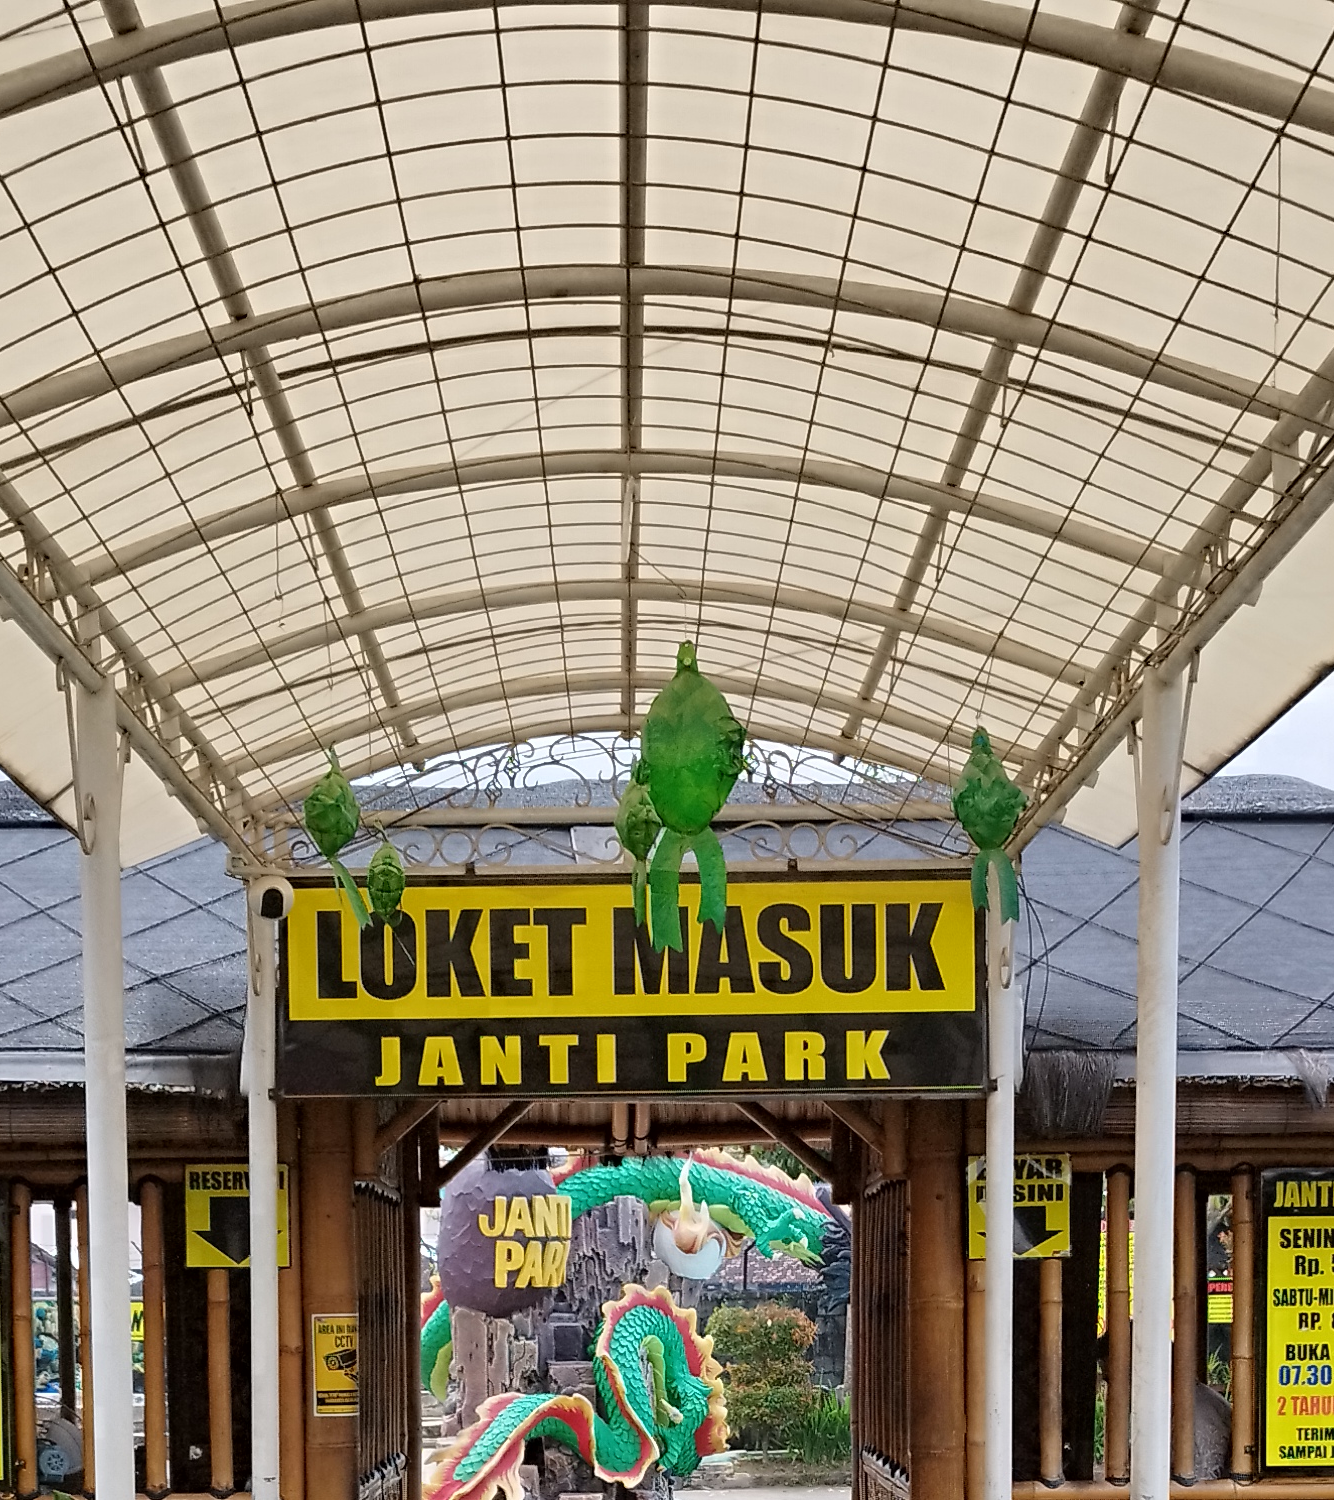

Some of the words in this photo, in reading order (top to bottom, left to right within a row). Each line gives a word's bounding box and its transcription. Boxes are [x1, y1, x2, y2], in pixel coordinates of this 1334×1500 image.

[317, 907, 586, 1000] LOKET
[613, 902, 946, 995] MASUK
[375, 1034, 616, 1086] JANTI
[668, 1030, 890, 1082] PARK
[189, 1171, 284, 1190] RESERI
[1294, 1255, 1325, 1276] Rp.
[1298, 1312, 1322, 1330] RP.
[1285, 1344, 1330, 1361] BUKA
[1278, 1364, 1332, 1386] 07.30
[1277, 1396, 1287, 1416] 2
[1279, 1446, 1327, 1459] SAMPAI
